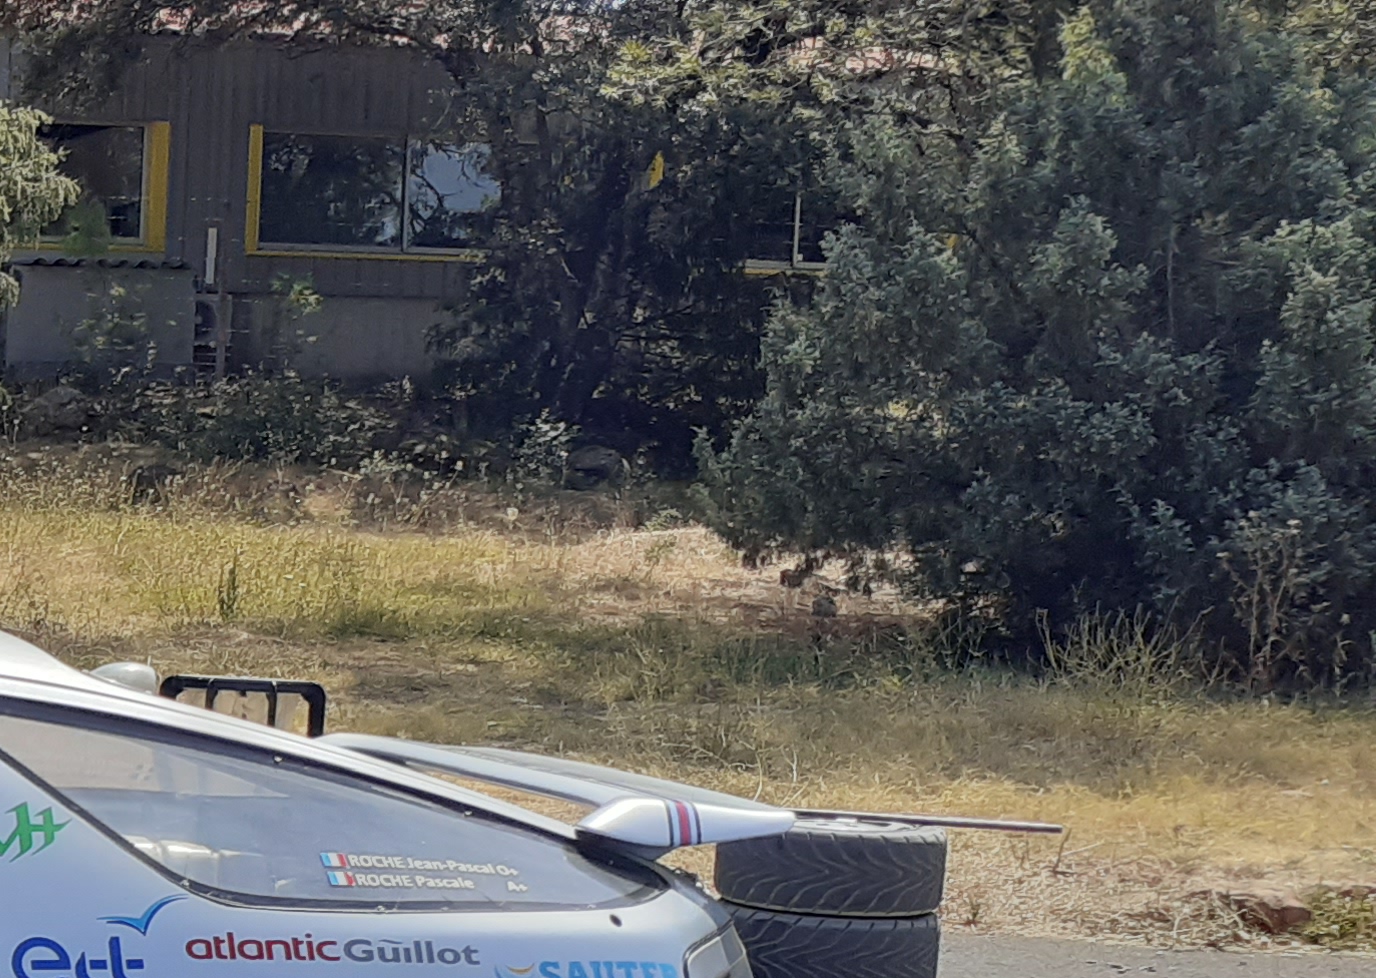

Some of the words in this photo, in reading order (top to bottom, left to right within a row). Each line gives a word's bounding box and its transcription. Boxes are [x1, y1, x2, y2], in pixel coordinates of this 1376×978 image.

[348, 854, 407, 869] ROCHE
[408, 857, 496, 875] Jean-Pascal
[354, 873, 414, 888] ROCHE
[415, 875, 475, 889] Pascale
[185, 932, 341, 961] atlantic
